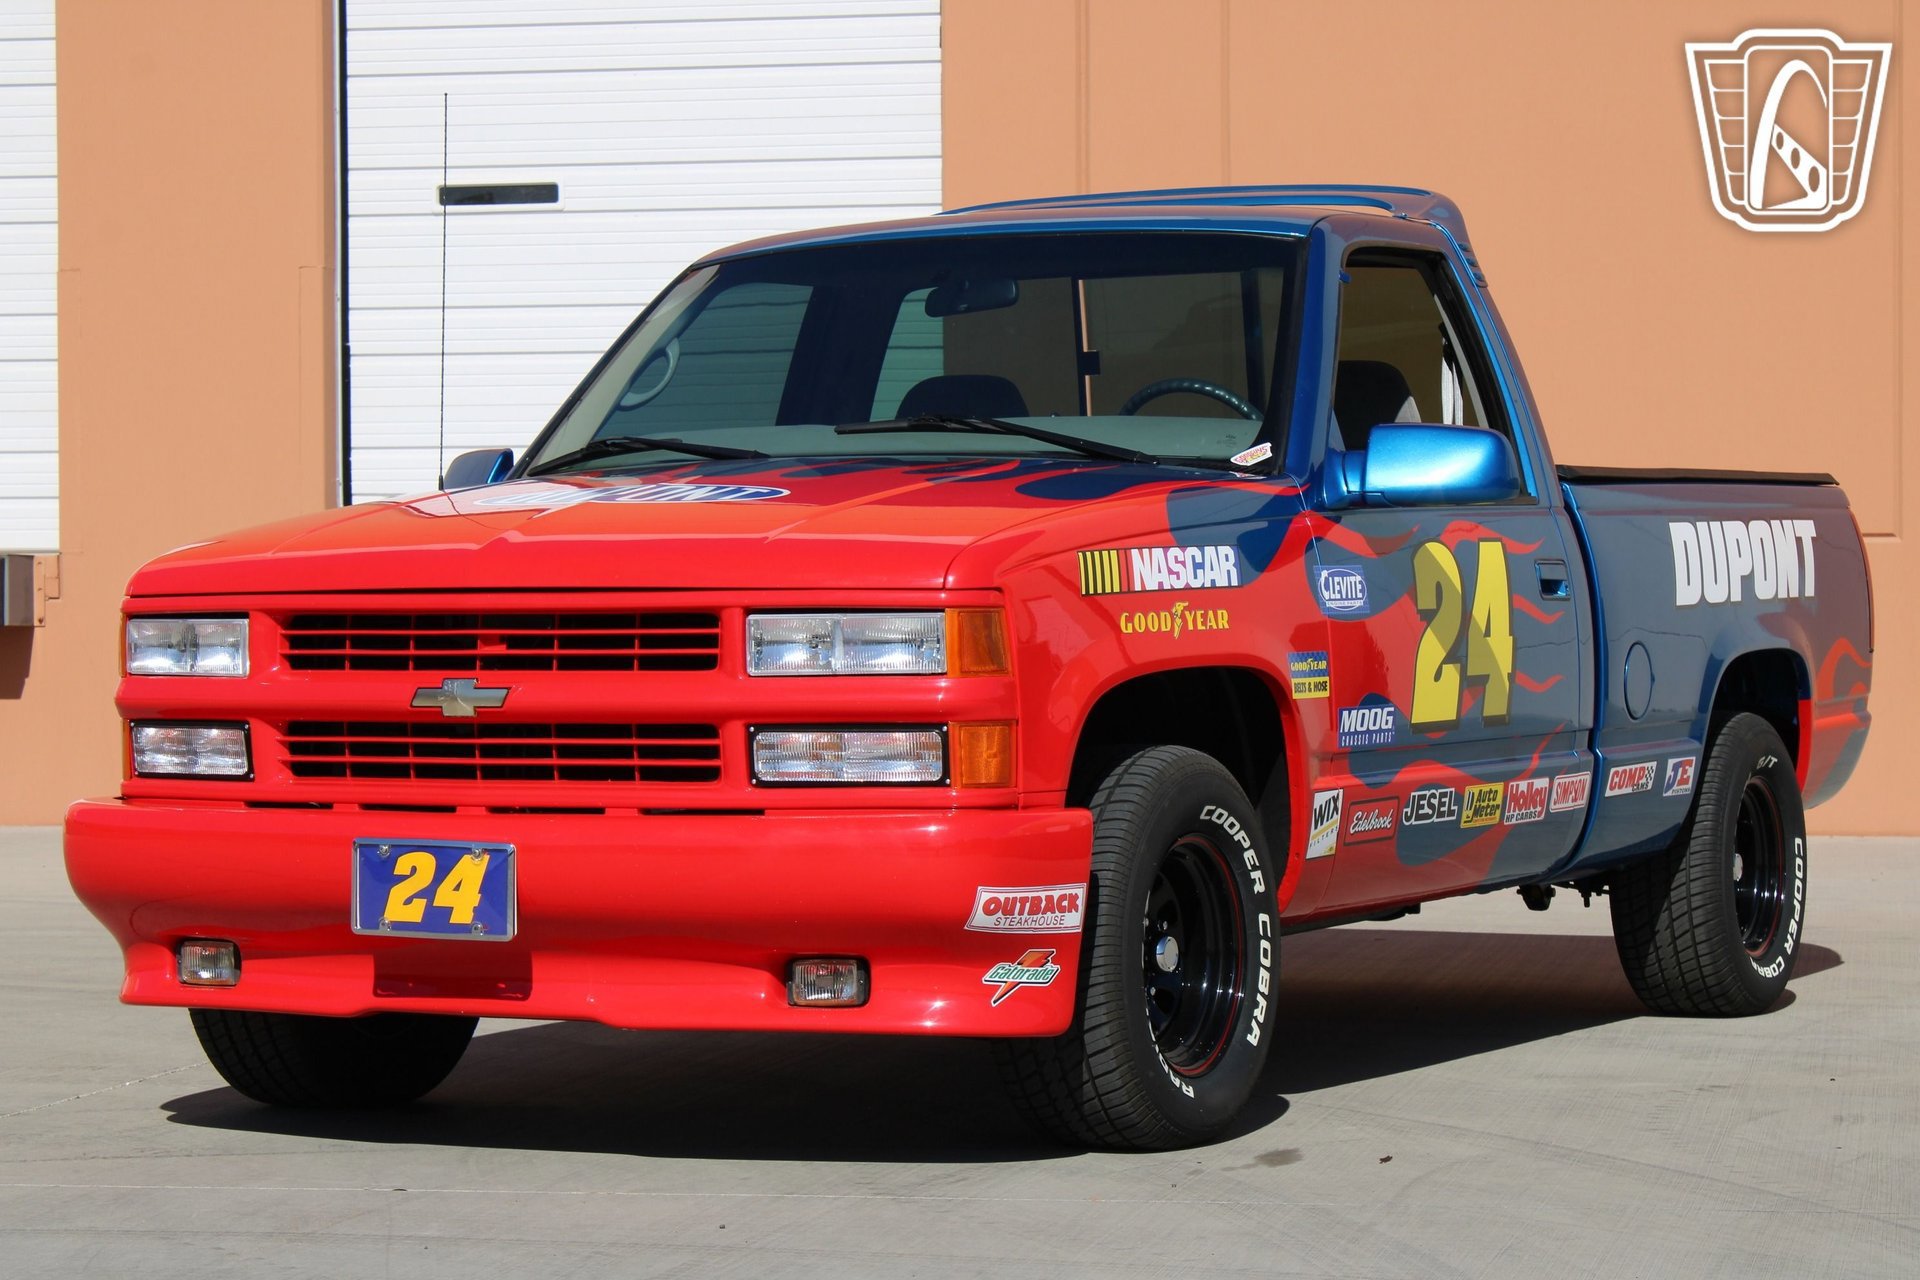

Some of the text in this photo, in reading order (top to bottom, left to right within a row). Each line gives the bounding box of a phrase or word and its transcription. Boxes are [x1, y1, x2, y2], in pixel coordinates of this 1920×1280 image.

[1130, 546, 1238, 591] NASCAR
[1669, 520, 1816, 606] DUPONT
[1321, 570, 1363, 600] CLEVITE
[1410, 540, 1513, 728] 24
[1308, 682, 1313, 692] &
[1314, 681, 1328, 692] HOSE
[1340, 707, 1394, 733] MOOG
[1341, 732, 1391, 747] CHASSIS PARTS
[1609, 766, 1646, 791] COMP
[1664, 759, 1694, 794] JE
[1475, 788, 1498, 803] Auto
[1507, 781, 1548, 818] Holley
[1554, 778, 1588, 805] SIMPSON
[1314, 793, 1339, 830] WIX
[1403, 788, 1458, 825] JESEL
[1473, 803, 1500, 818] Meter
[1516, 811, 1537, 821] CARBS
[1350, 809, 1394, 834] Edelbrock
[384, 851, 491, 924] 24
[1784, 837, 1804, 955] COOPER
[982, 893, 1079, 916] OUTBACK
[994, 915, 1065, 927] STEAKHOUSE
[1200, 805, 1271, 1047] COOPER COBRA
[989, 963, 1055, 981] Gatorade
